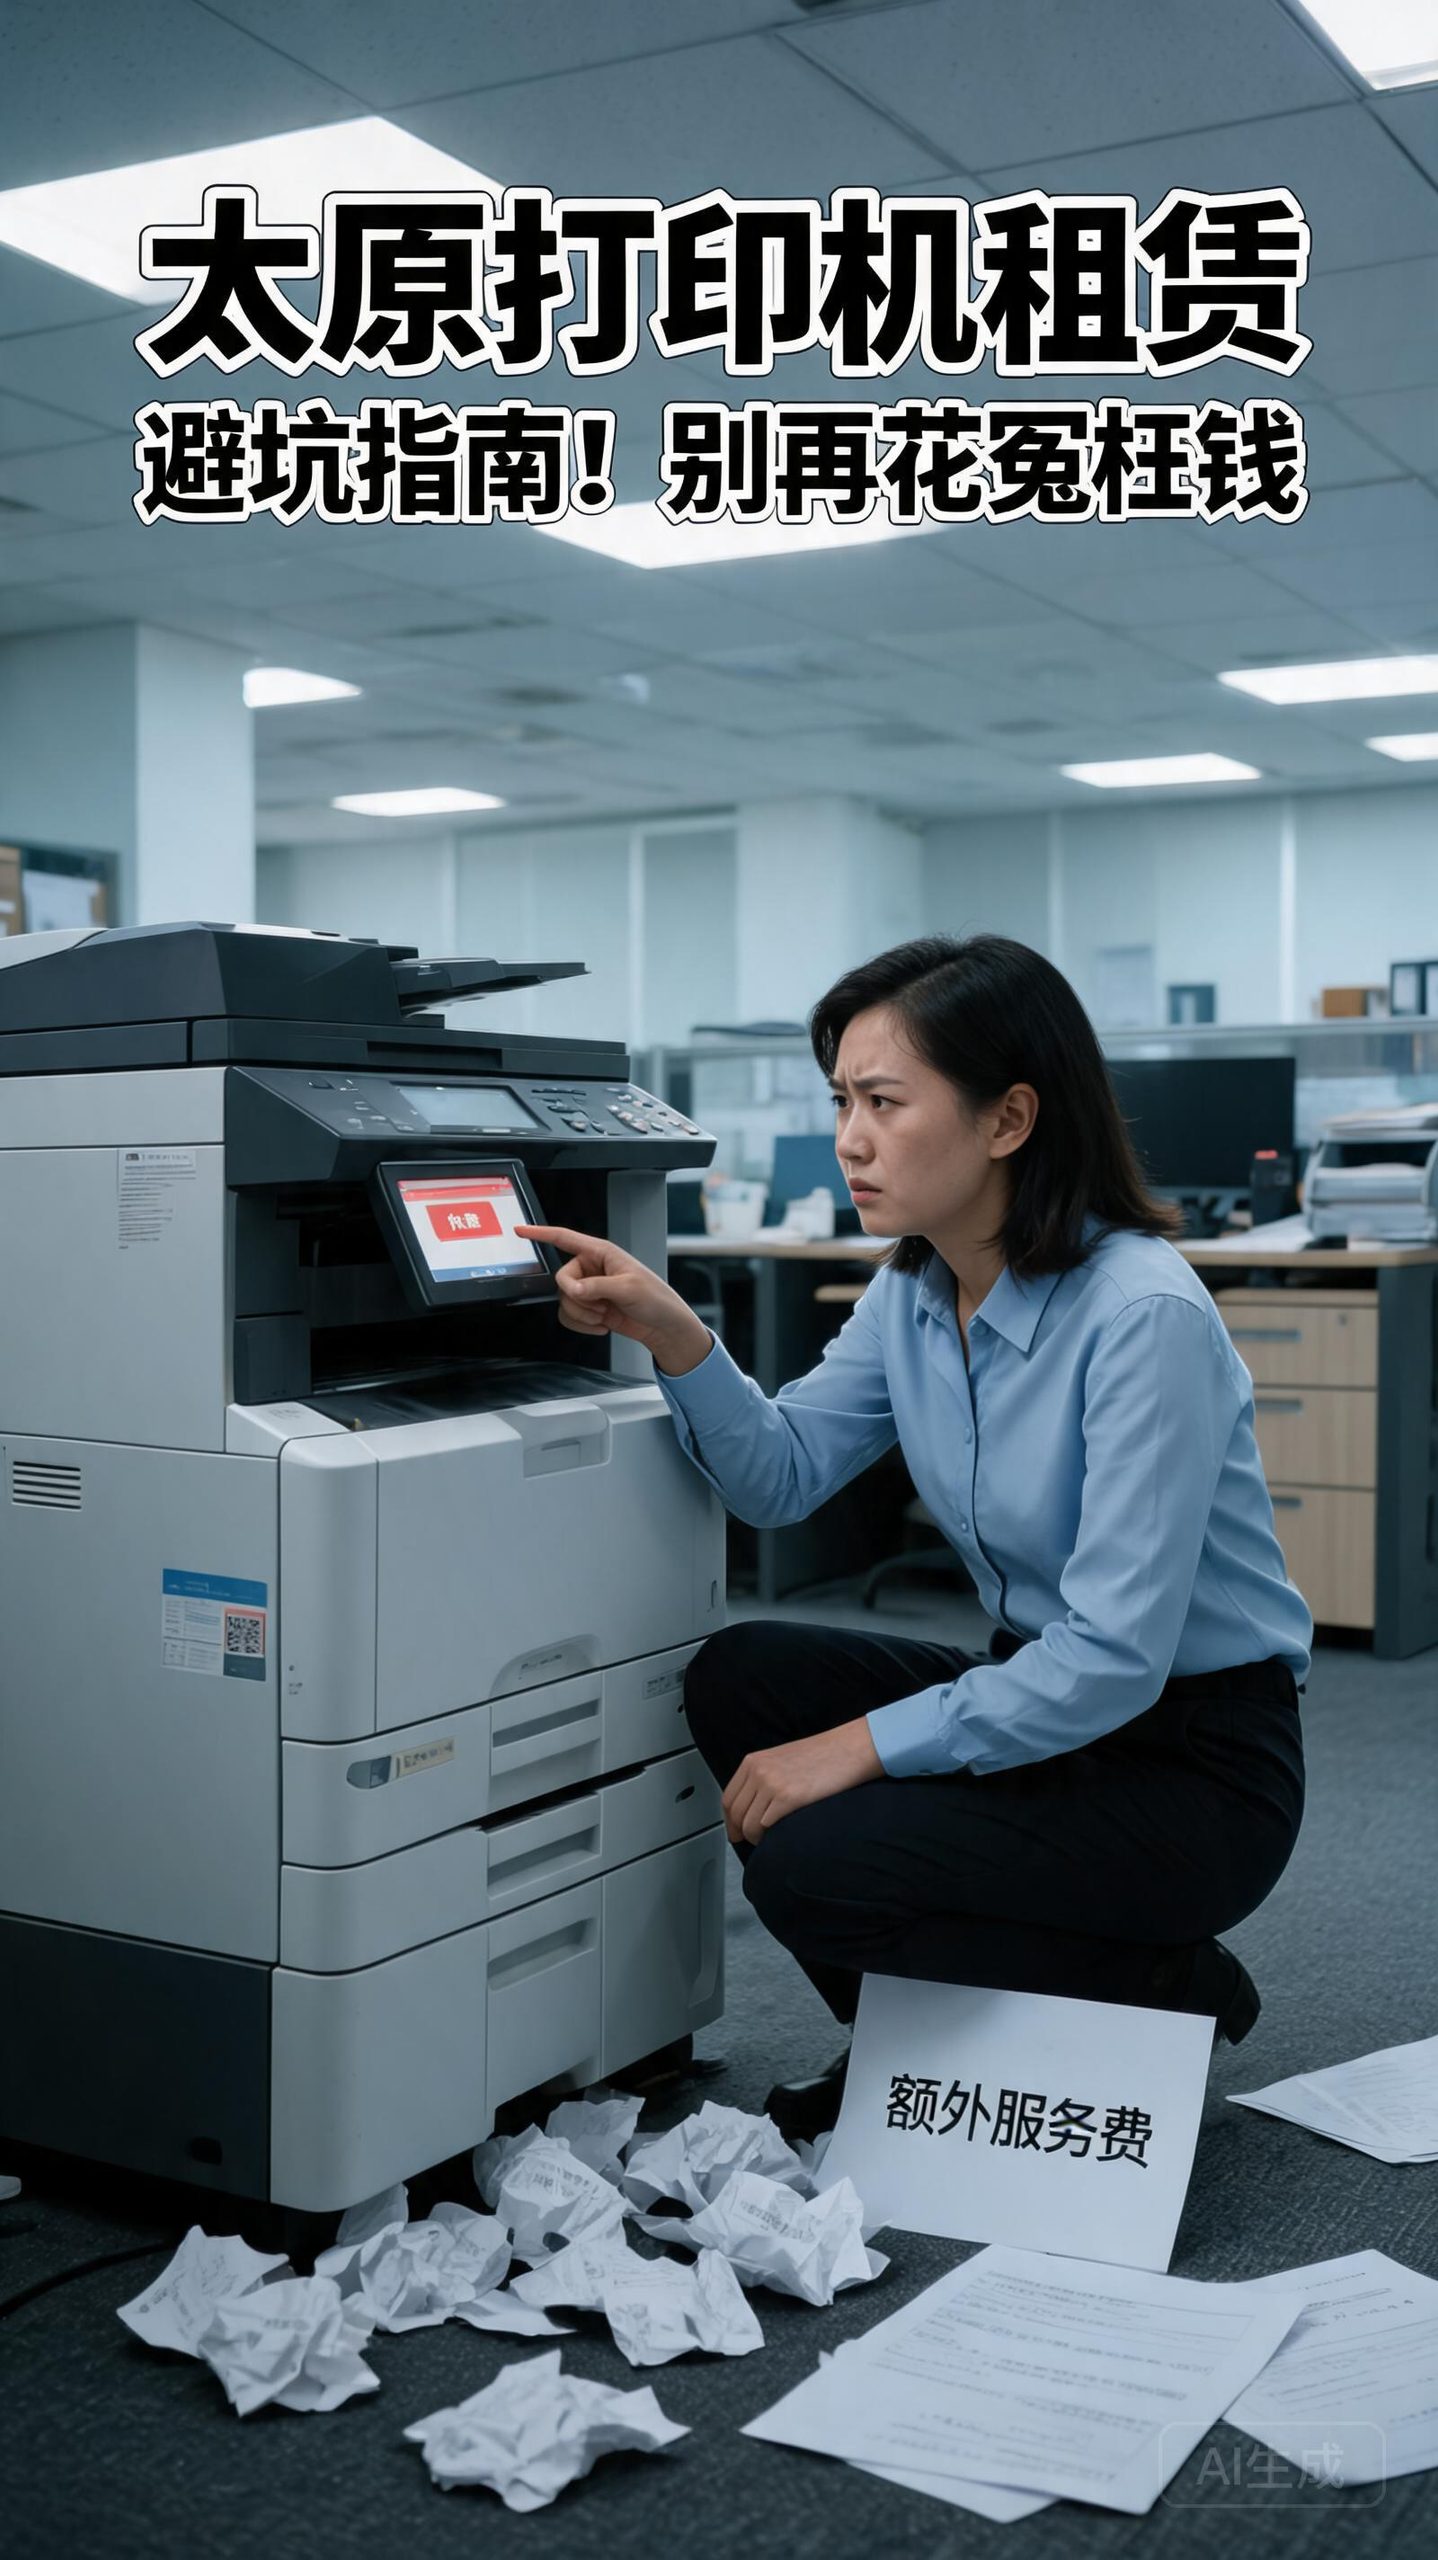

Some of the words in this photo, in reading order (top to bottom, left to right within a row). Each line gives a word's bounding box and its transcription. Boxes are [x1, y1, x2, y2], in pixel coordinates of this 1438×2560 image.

[885, 2072, 1155, 2170] 额外服务费
